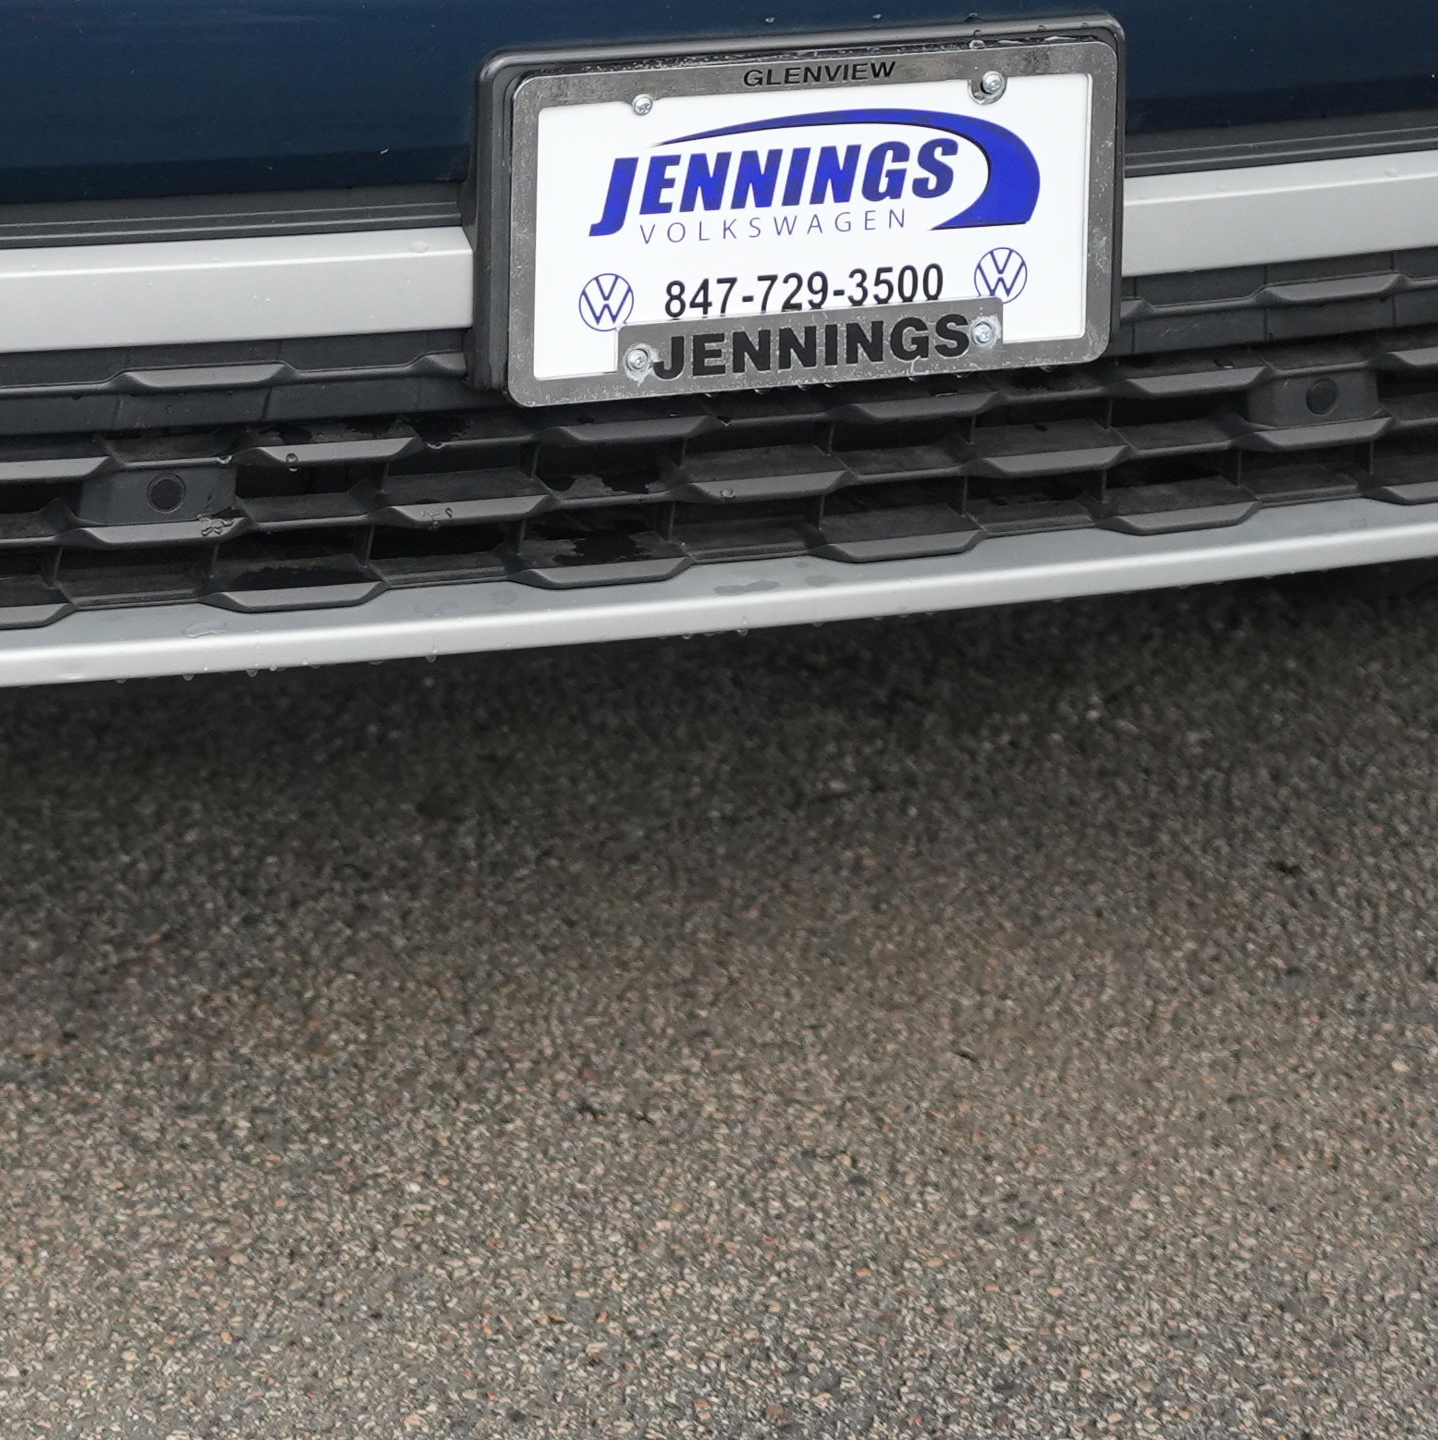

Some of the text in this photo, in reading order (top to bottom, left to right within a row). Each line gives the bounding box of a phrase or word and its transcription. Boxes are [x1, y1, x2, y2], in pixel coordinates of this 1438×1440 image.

[743, 61, 896, 87] GLENVIEW
[589, 138, 959, 237] JENNINGS
[639, 208, 906, 245] VOLKSWAGEN
[664, 263, 944, 319] 847-729-3500
[652, 314, 970, 380] JENNINGS
